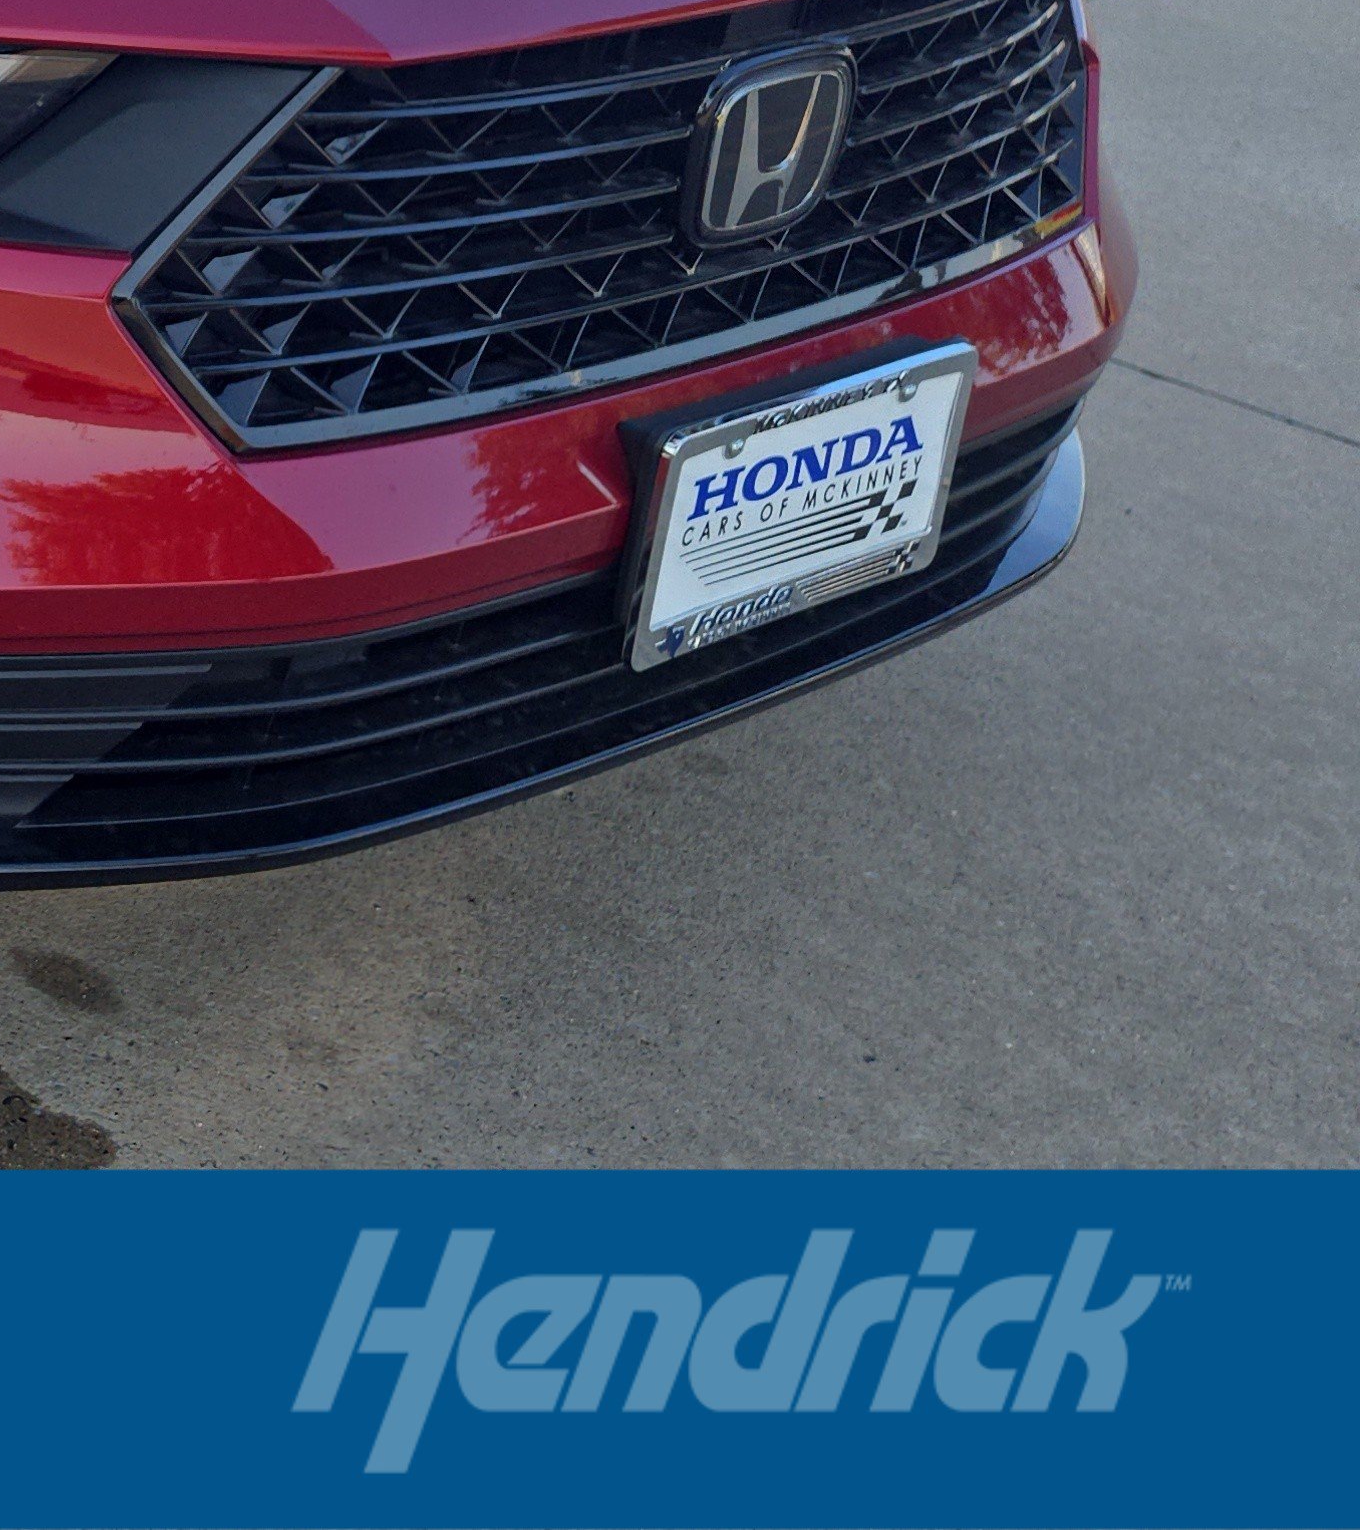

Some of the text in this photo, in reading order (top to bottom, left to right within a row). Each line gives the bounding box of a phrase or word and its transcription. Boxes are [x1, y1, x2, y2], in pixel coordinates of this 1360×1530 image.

[682, 455, 923, 547] CARS OF MCKINNEY
[687, 415, 923, 521] HONDA
